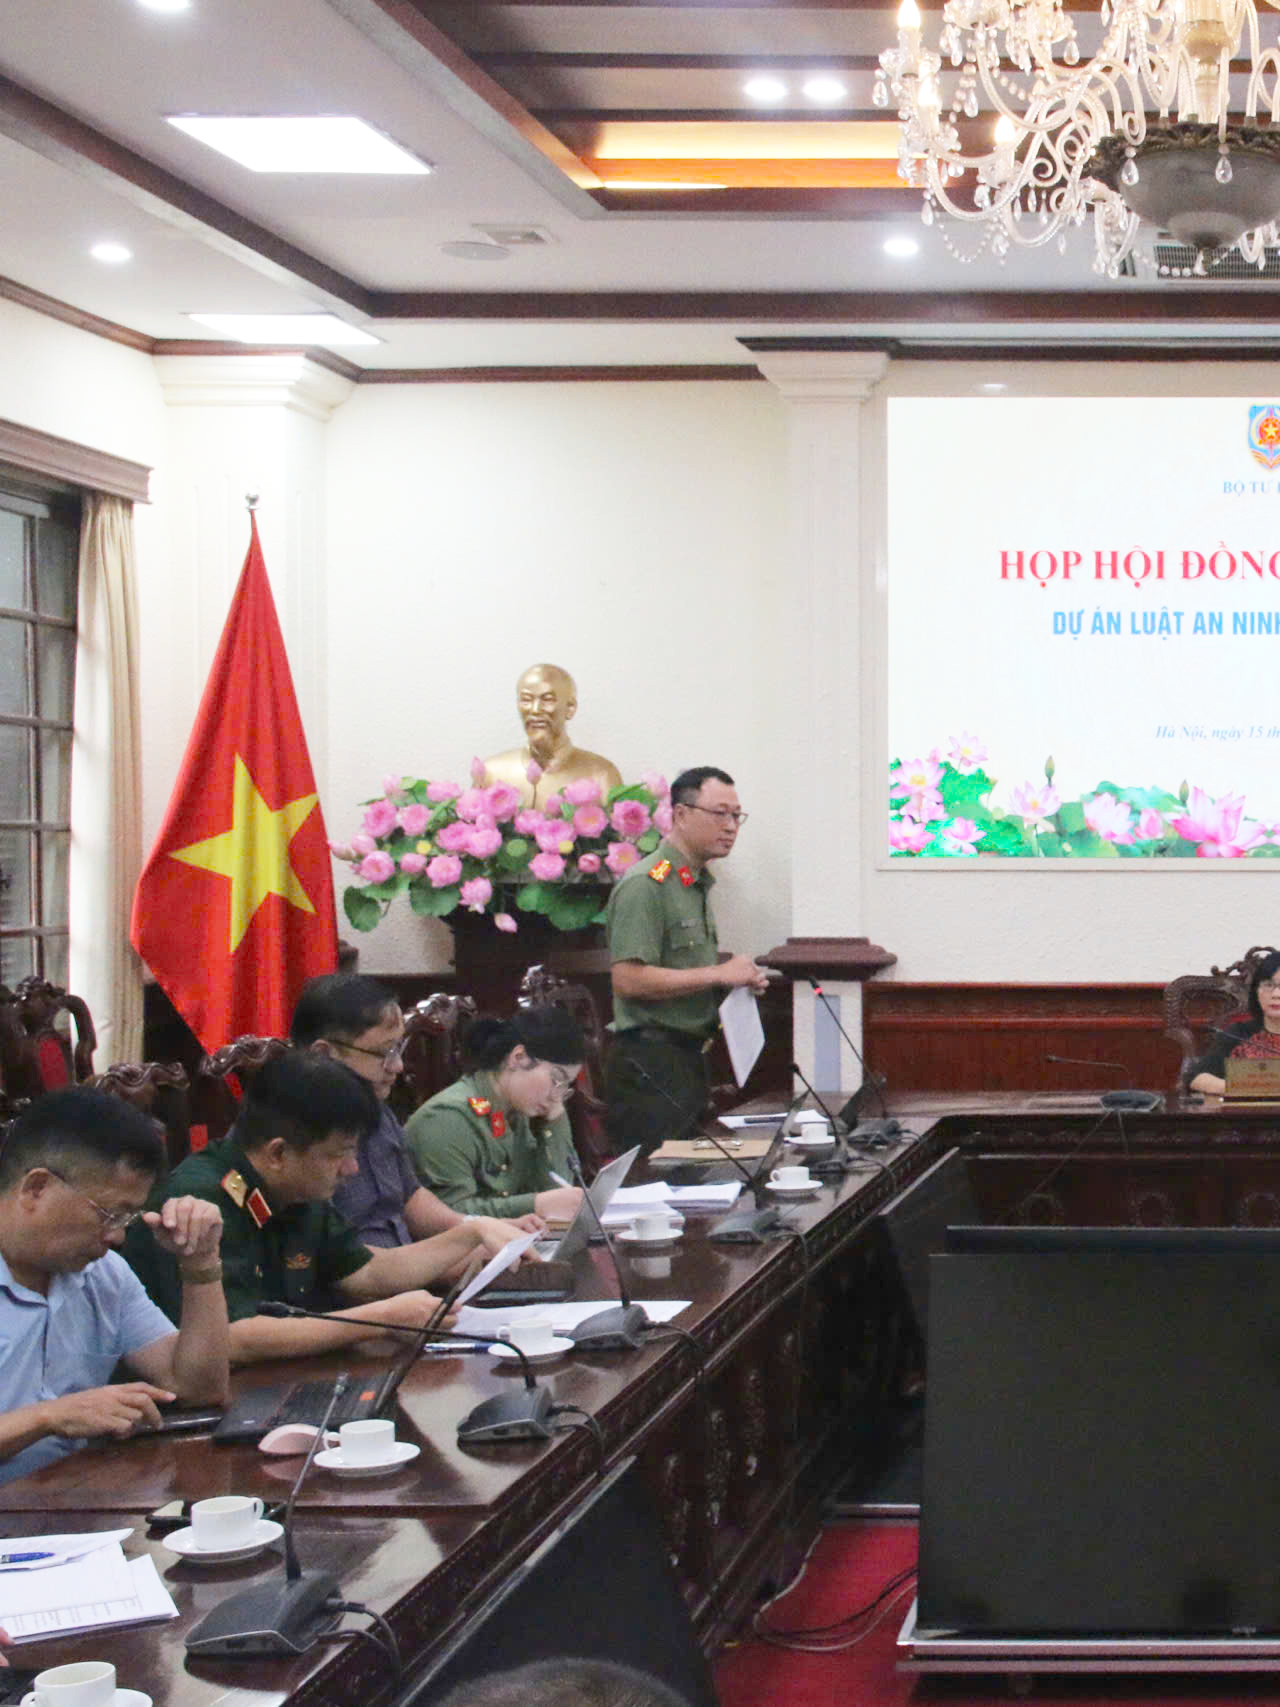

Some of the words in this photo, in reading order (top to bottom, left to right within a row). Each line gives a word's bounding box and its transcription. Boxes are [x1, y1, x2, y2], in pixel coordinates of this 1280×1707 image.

[1249, 479, 1274, 493] TƯ
[1000, 550, 1082, 588] HỌP
[1094, 545, 1165, 588] HỘI
[1053, 609, 1084, 640] DỰ
[1091, 606, 1121, 635] ÁN
[1131, 606, 1184, 641] LUẬT
[1193, 611, 1223, 635] AN
[1156, 725, 1175, 738] Hà
[1212, 725, 1242, 741] ngày
[1249, 725, 1264, 737] 15
